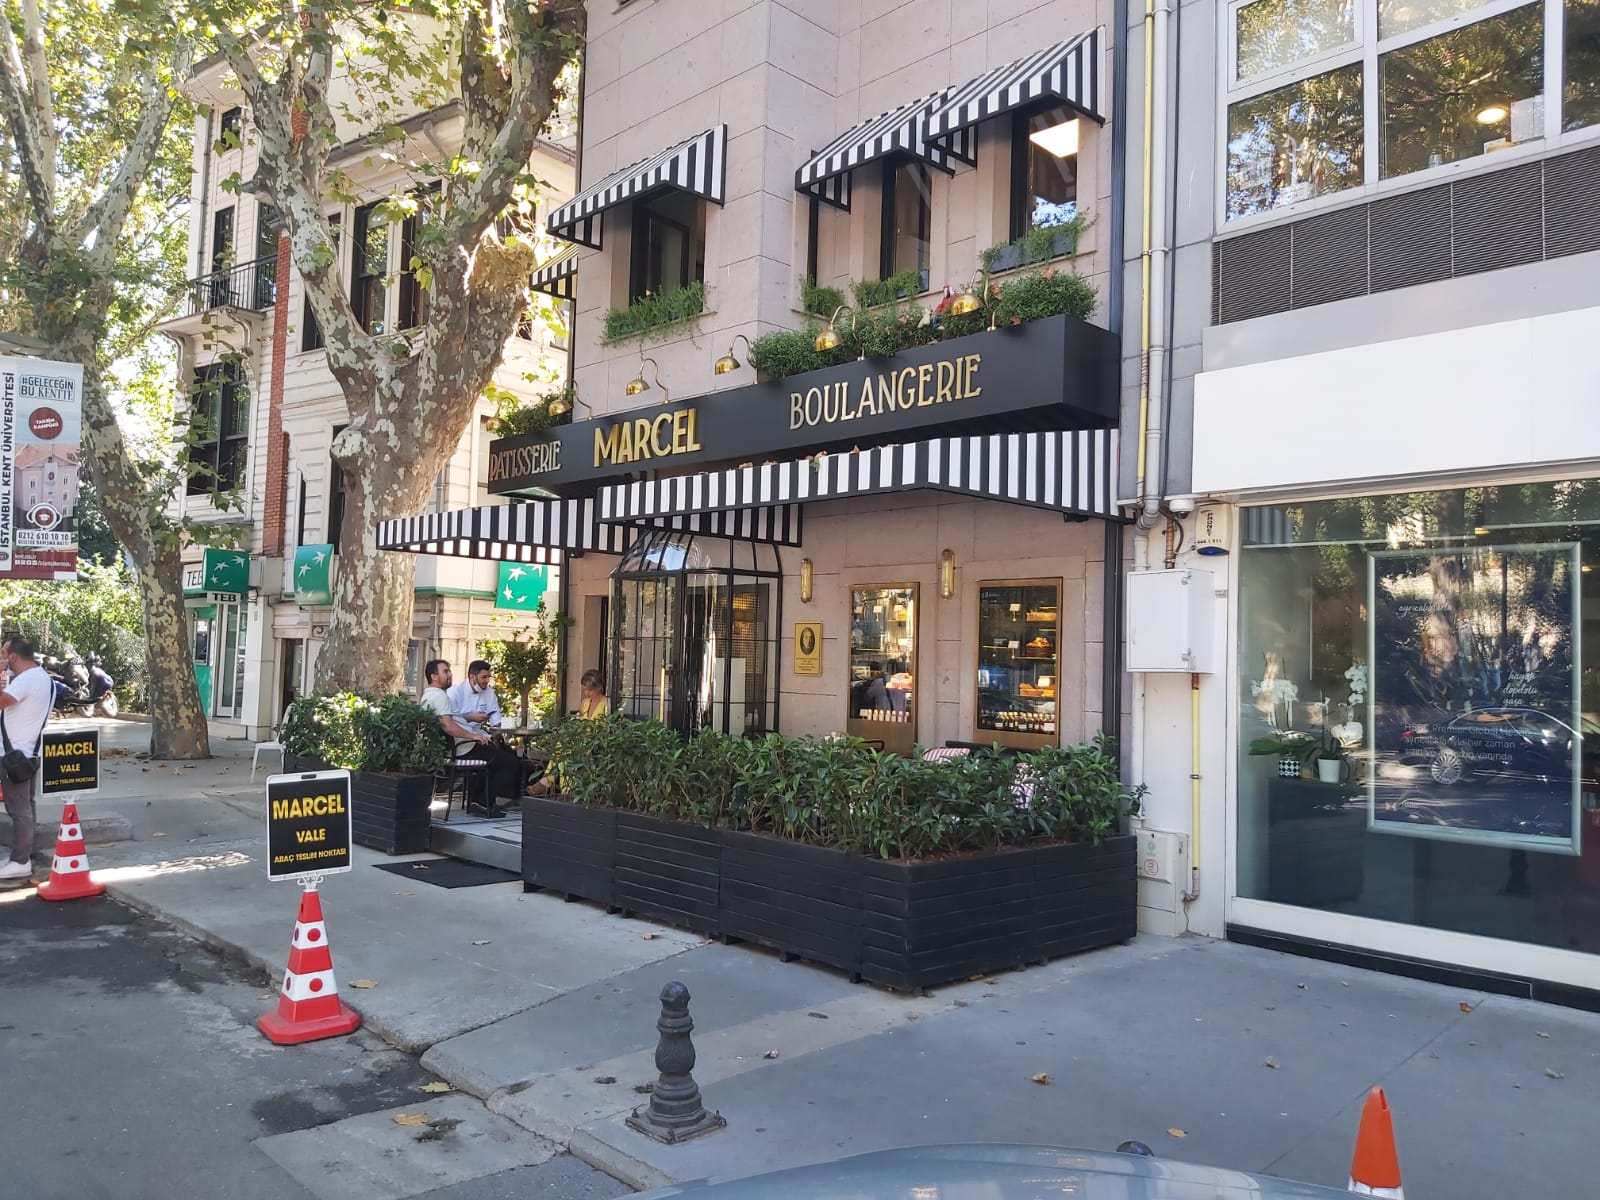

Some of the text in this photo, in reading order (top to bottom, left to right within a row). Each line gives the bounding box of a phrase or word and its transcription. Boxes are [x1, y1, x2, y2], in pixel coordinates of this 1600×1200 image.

[21, 385, 35, 396] BU
[789, 354, 982, 429] BOULANGERIE
[1, 372, 14, 452] ÜNİVERSİTESİ
[593, 408, 702, 467] MARCEL
[489, 440, 562, 481] PATISSERIE
[2, 455, 12, 486] KENT
[18, 531, 34, 540] 0212
[212, 592, 237, 603] TEB
[45, 741, 95, 758] MARCEL
[1485, 740, 1516, 749] zaman
[60, 763, 81, 773] VALE
[273, 793, 345, 820] MARCEL
[296, 828, 327, 843] VALE
[274, 854, 295, 864] ARAÇ
[318, 847, 347, 858] NOKTASI
